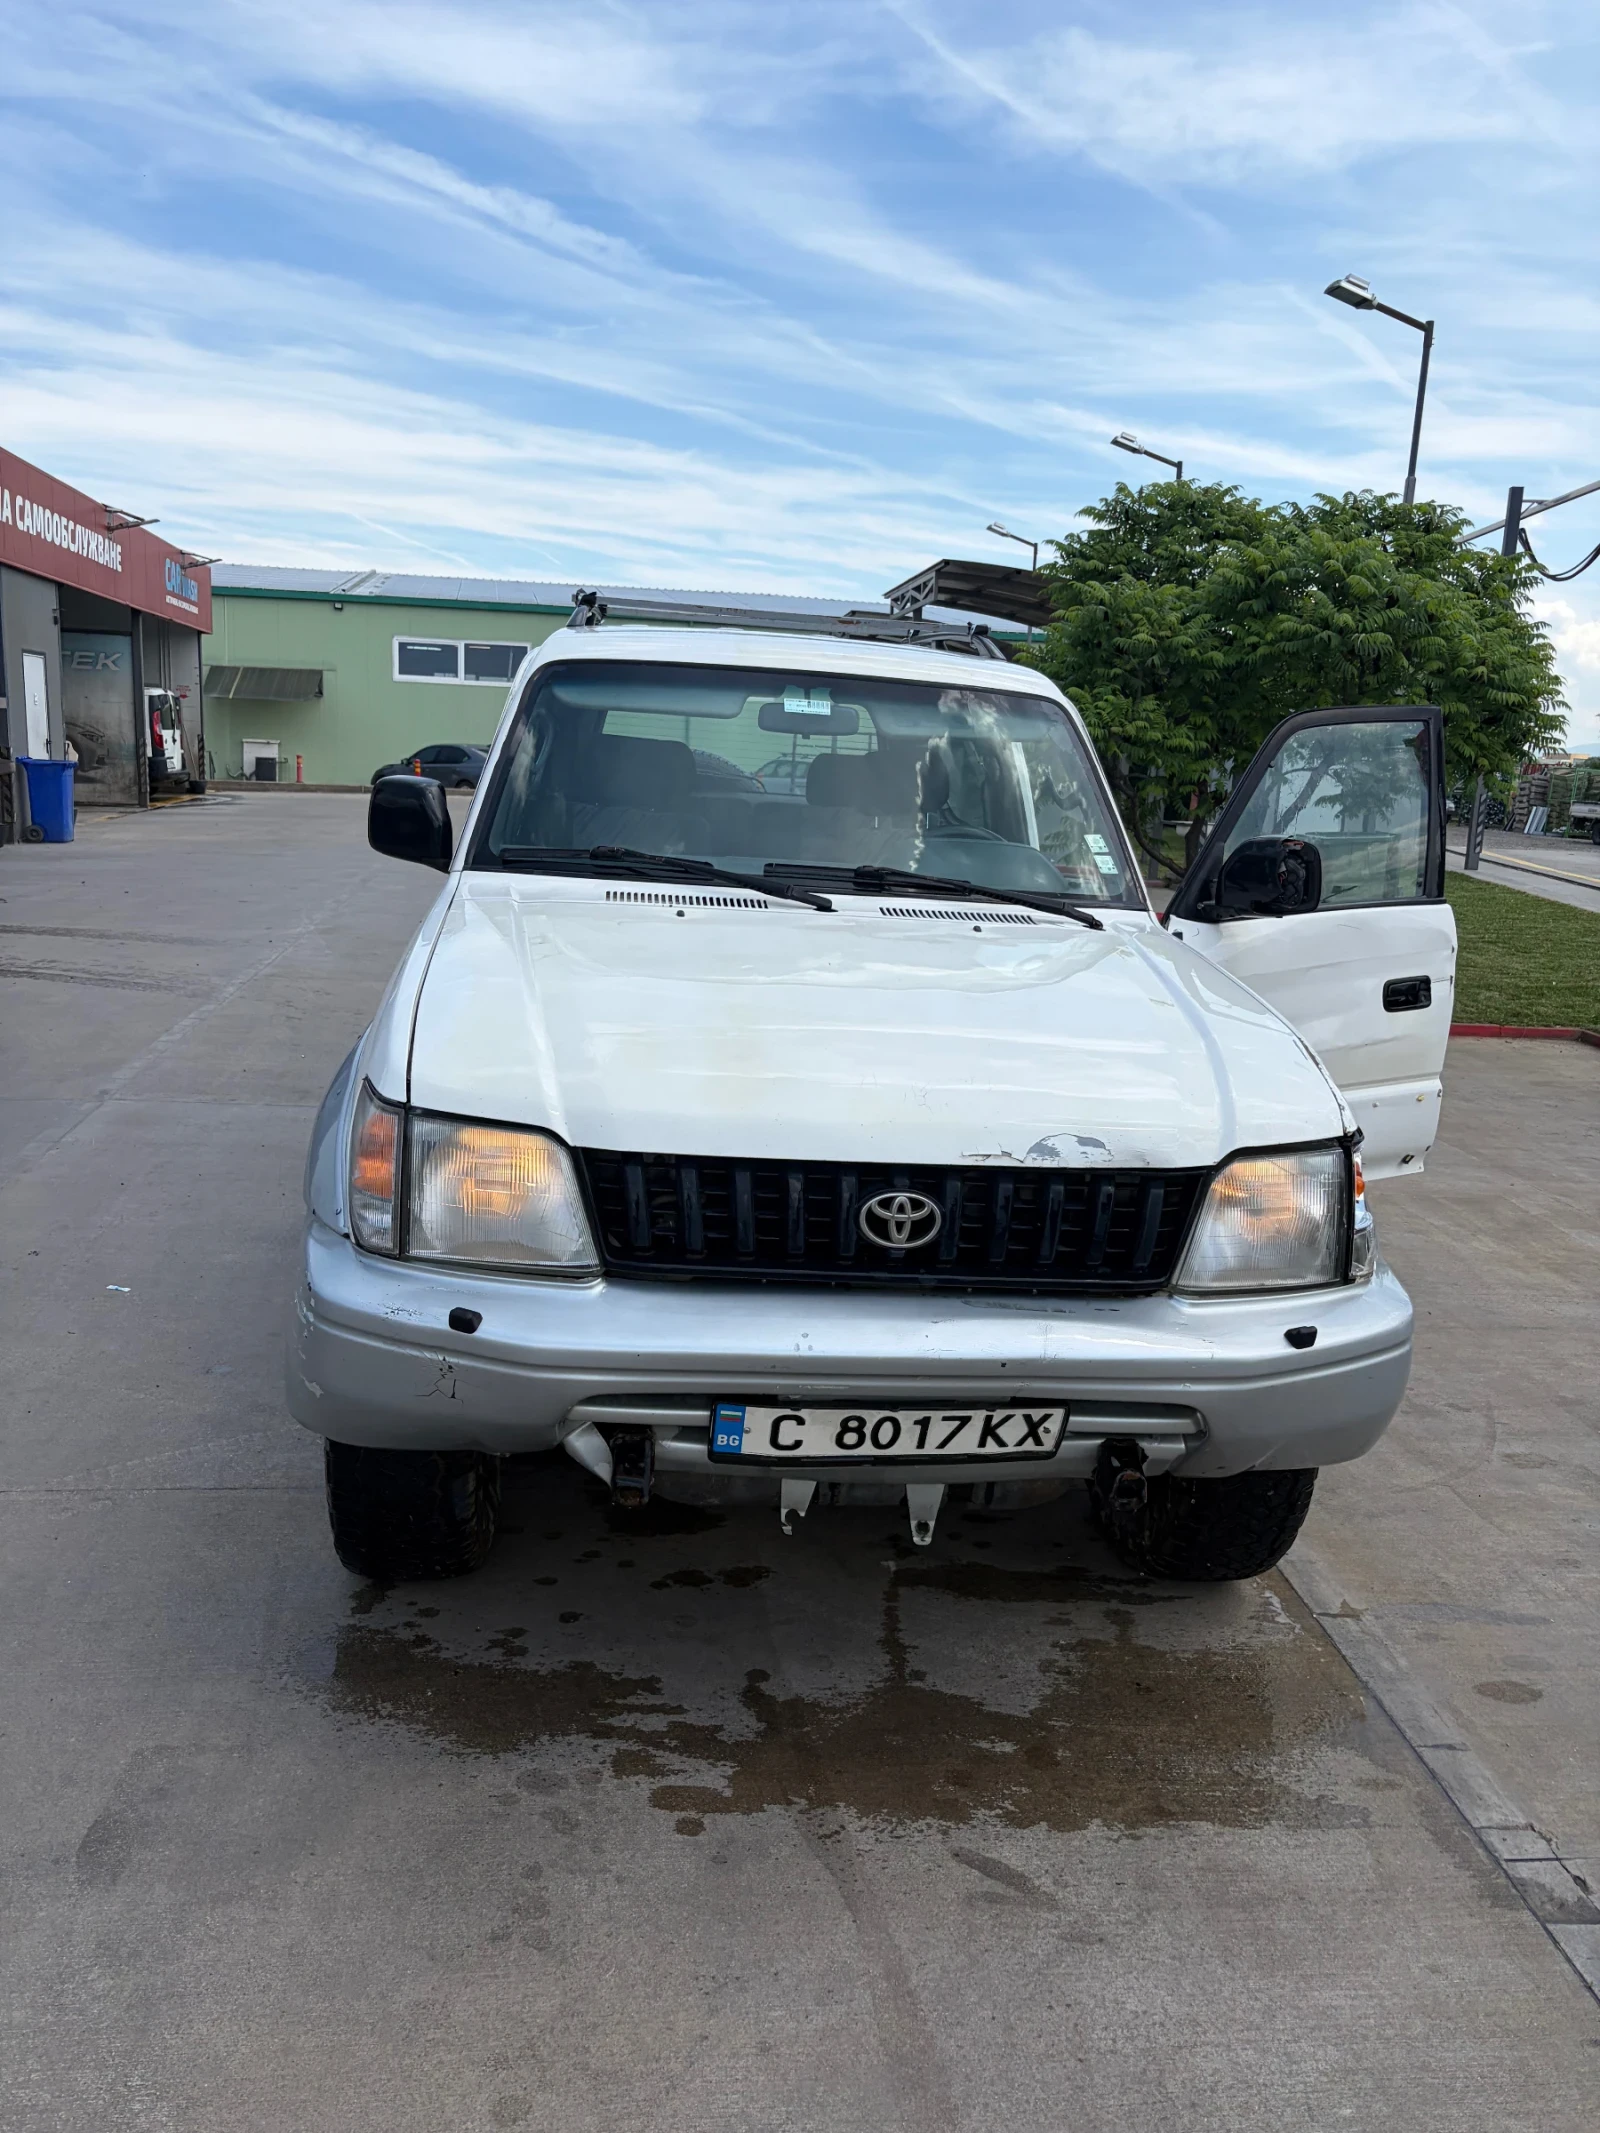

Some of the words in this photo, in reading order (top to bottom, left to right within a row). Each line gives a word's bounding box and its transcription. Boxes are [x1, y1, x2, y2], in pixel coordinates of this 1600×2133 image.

[0, 486, 12, 526] А
[15, 495, 122, 572] САМООБСЛУЖВАНЕ
[717, 1434, 740, 1446] BG
